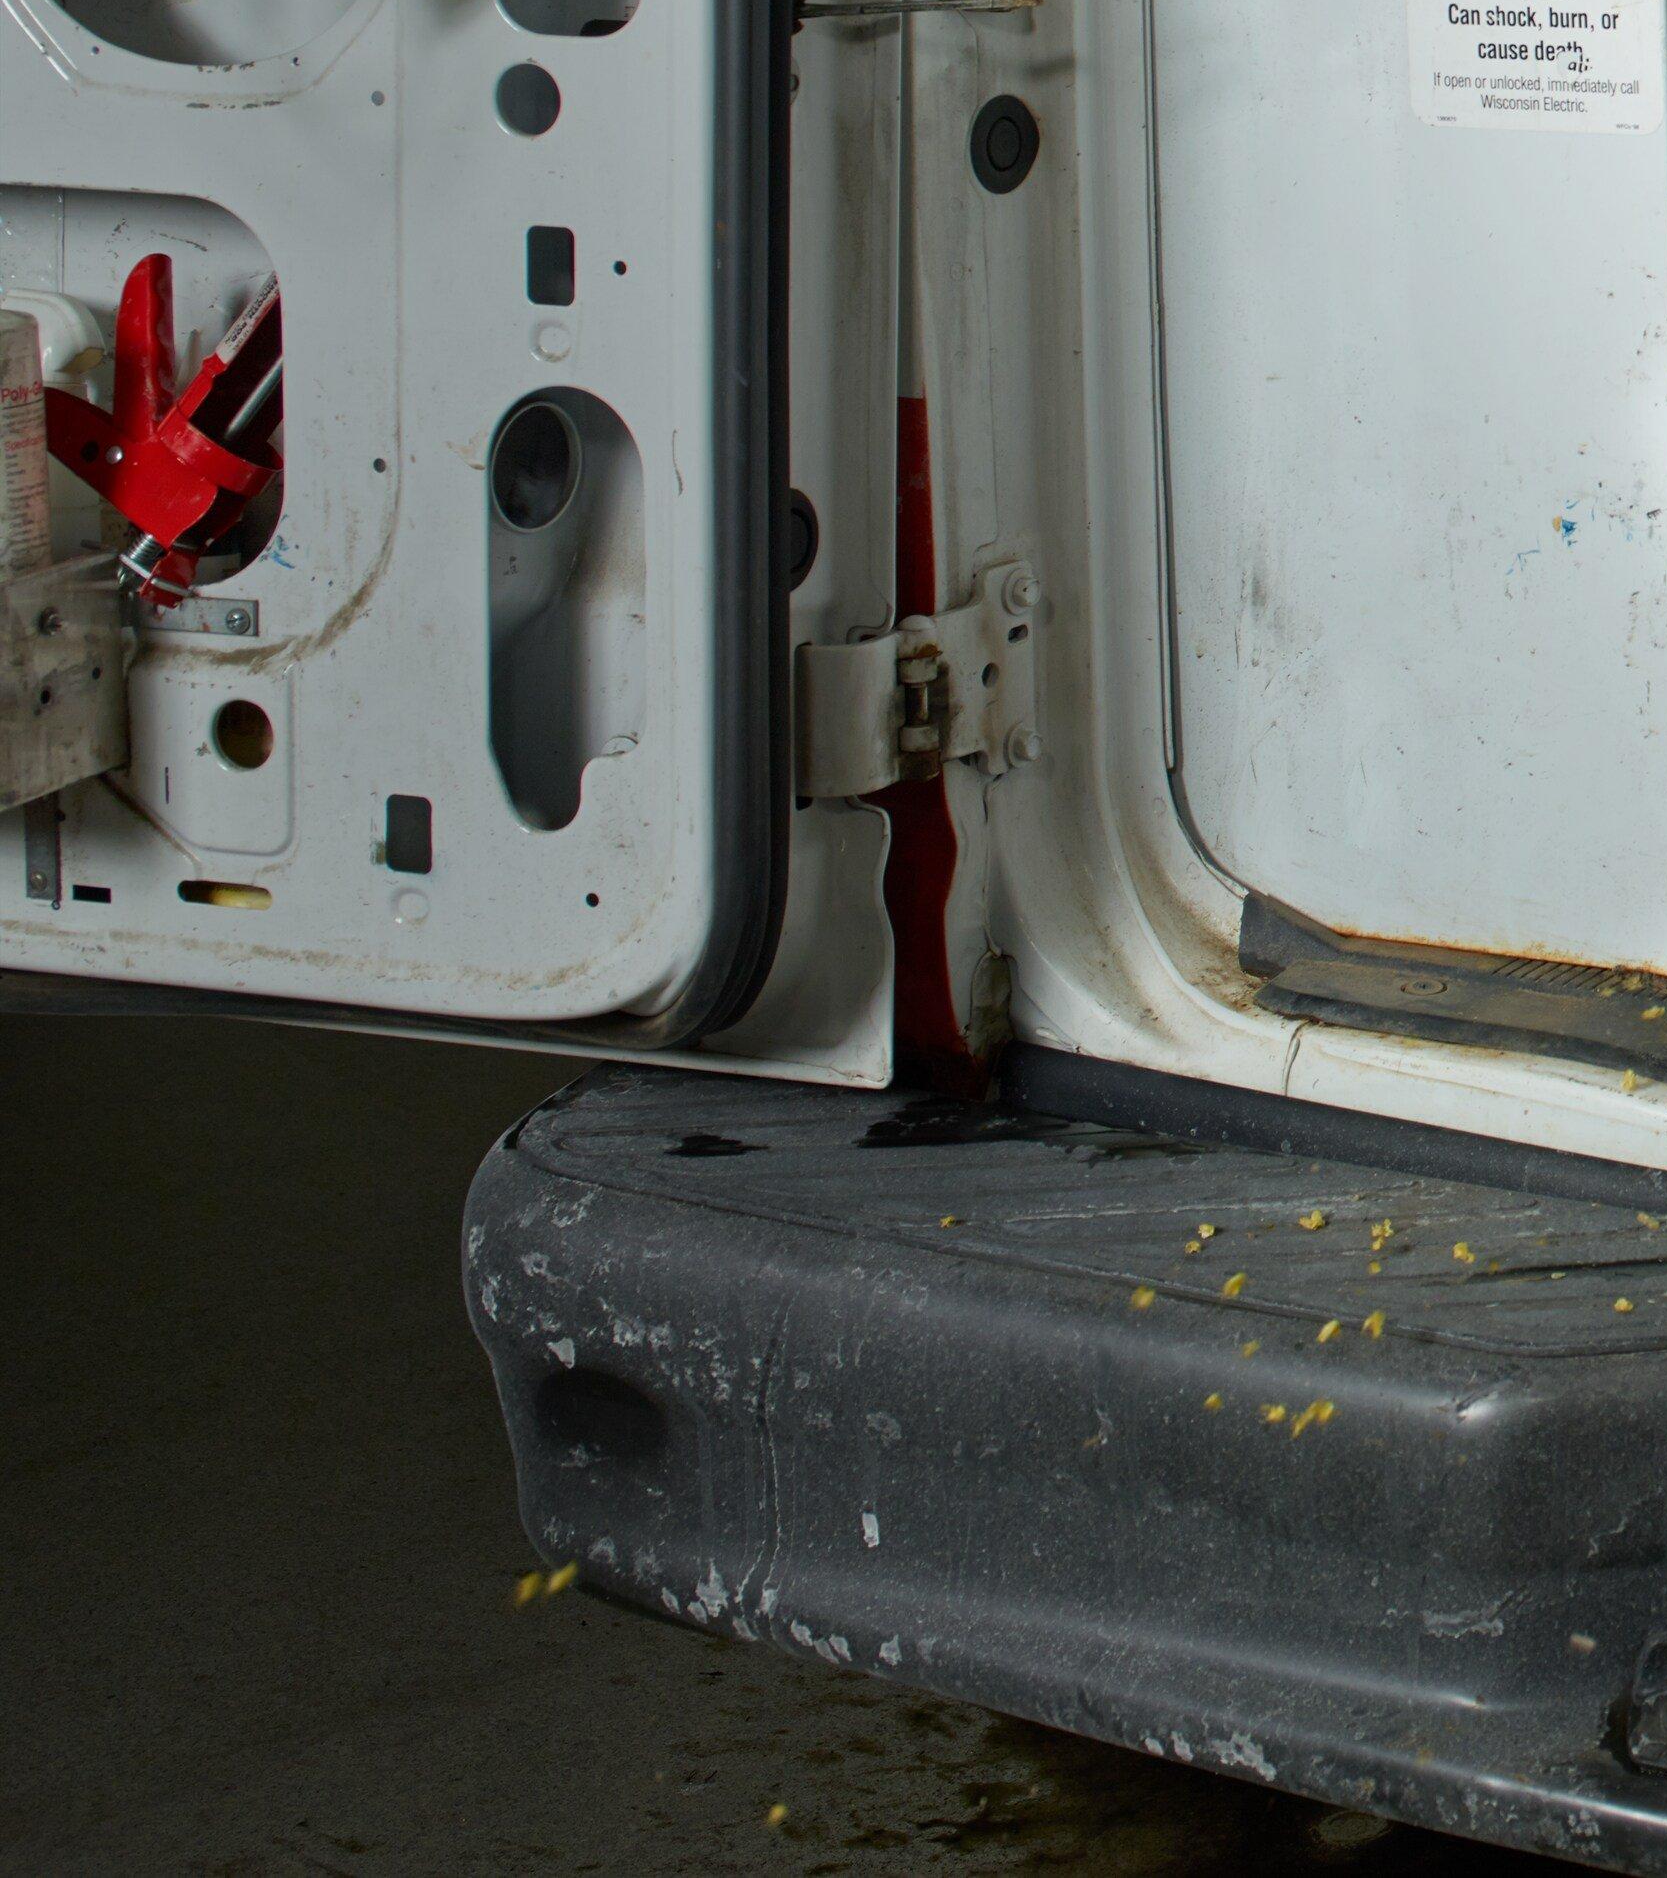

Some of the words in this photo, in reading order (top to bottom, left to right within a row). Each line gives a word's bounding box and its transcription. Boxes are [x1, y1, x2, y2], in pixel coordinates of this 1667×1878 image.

[1448, 3, 1481, 26] Can
[1486, 6, 1543, 31] shock,
[1549, 7, 1596, 32] burn,
[1601, 12, 1619, 30] or
[1477, 42, 1529, 61] cause
[1433, 72, 1442, 87] If
[1444, 75, 1472, 90] open
[1475, 78, 1487, 90] or
[1489, 76, 1545, 93] unlocked,
[1547, 77, 1617, 97] immediately
[1620, 79, 1640, 95] call
[1480, 94, 1540, 112] Wisconsin
[1543, 96, 1588, 113] Electric.
